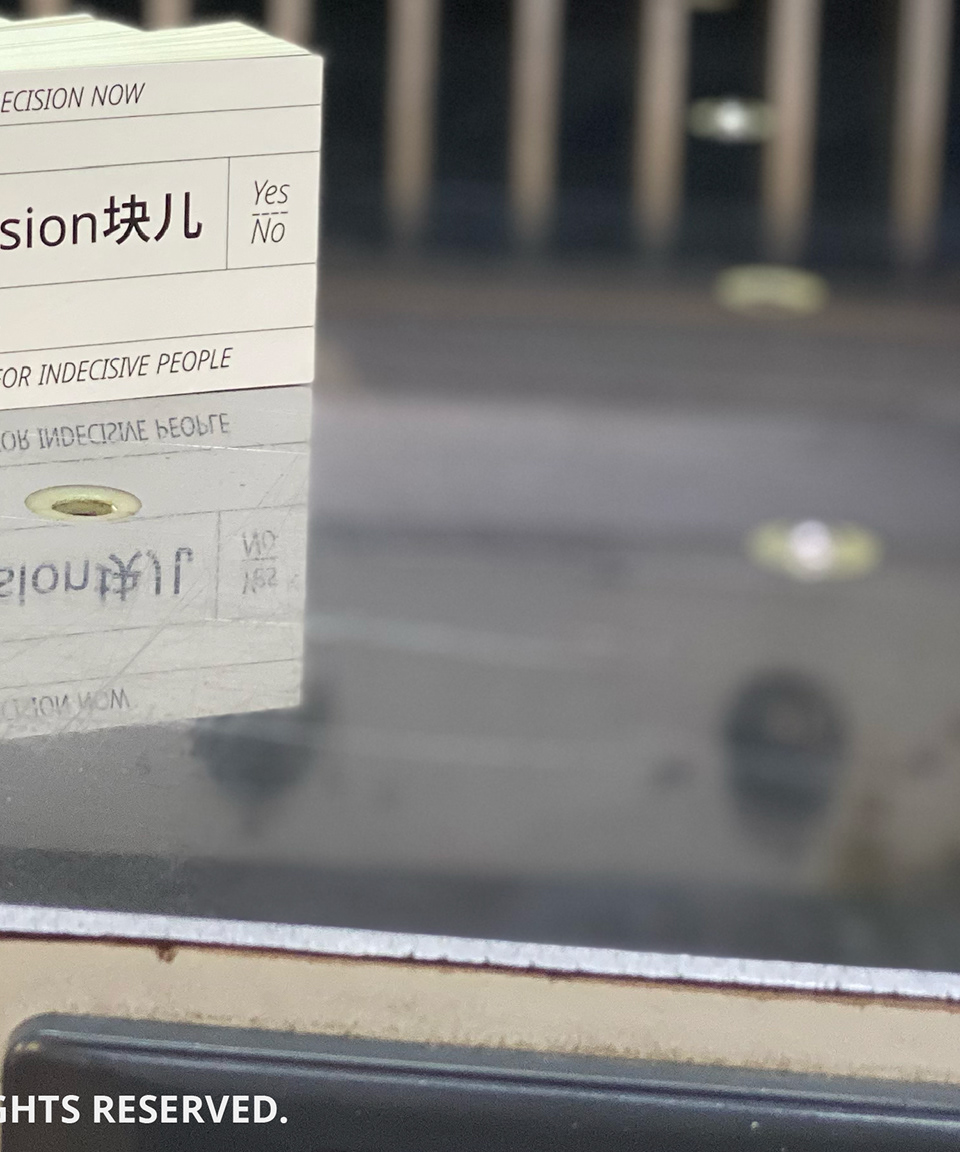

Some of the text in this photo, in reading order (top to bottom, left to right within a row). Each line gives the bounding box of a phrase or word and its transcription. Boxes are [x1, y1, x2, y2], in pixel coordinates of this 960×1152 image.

[91, 82, 146, 107] NOW
[253, 179, 290, 205] Yes
[250, 218, 286, 245] No
[38, 354, 151, 386] INDECISIVE
[156, 347, 233, 374] PEOPLE
